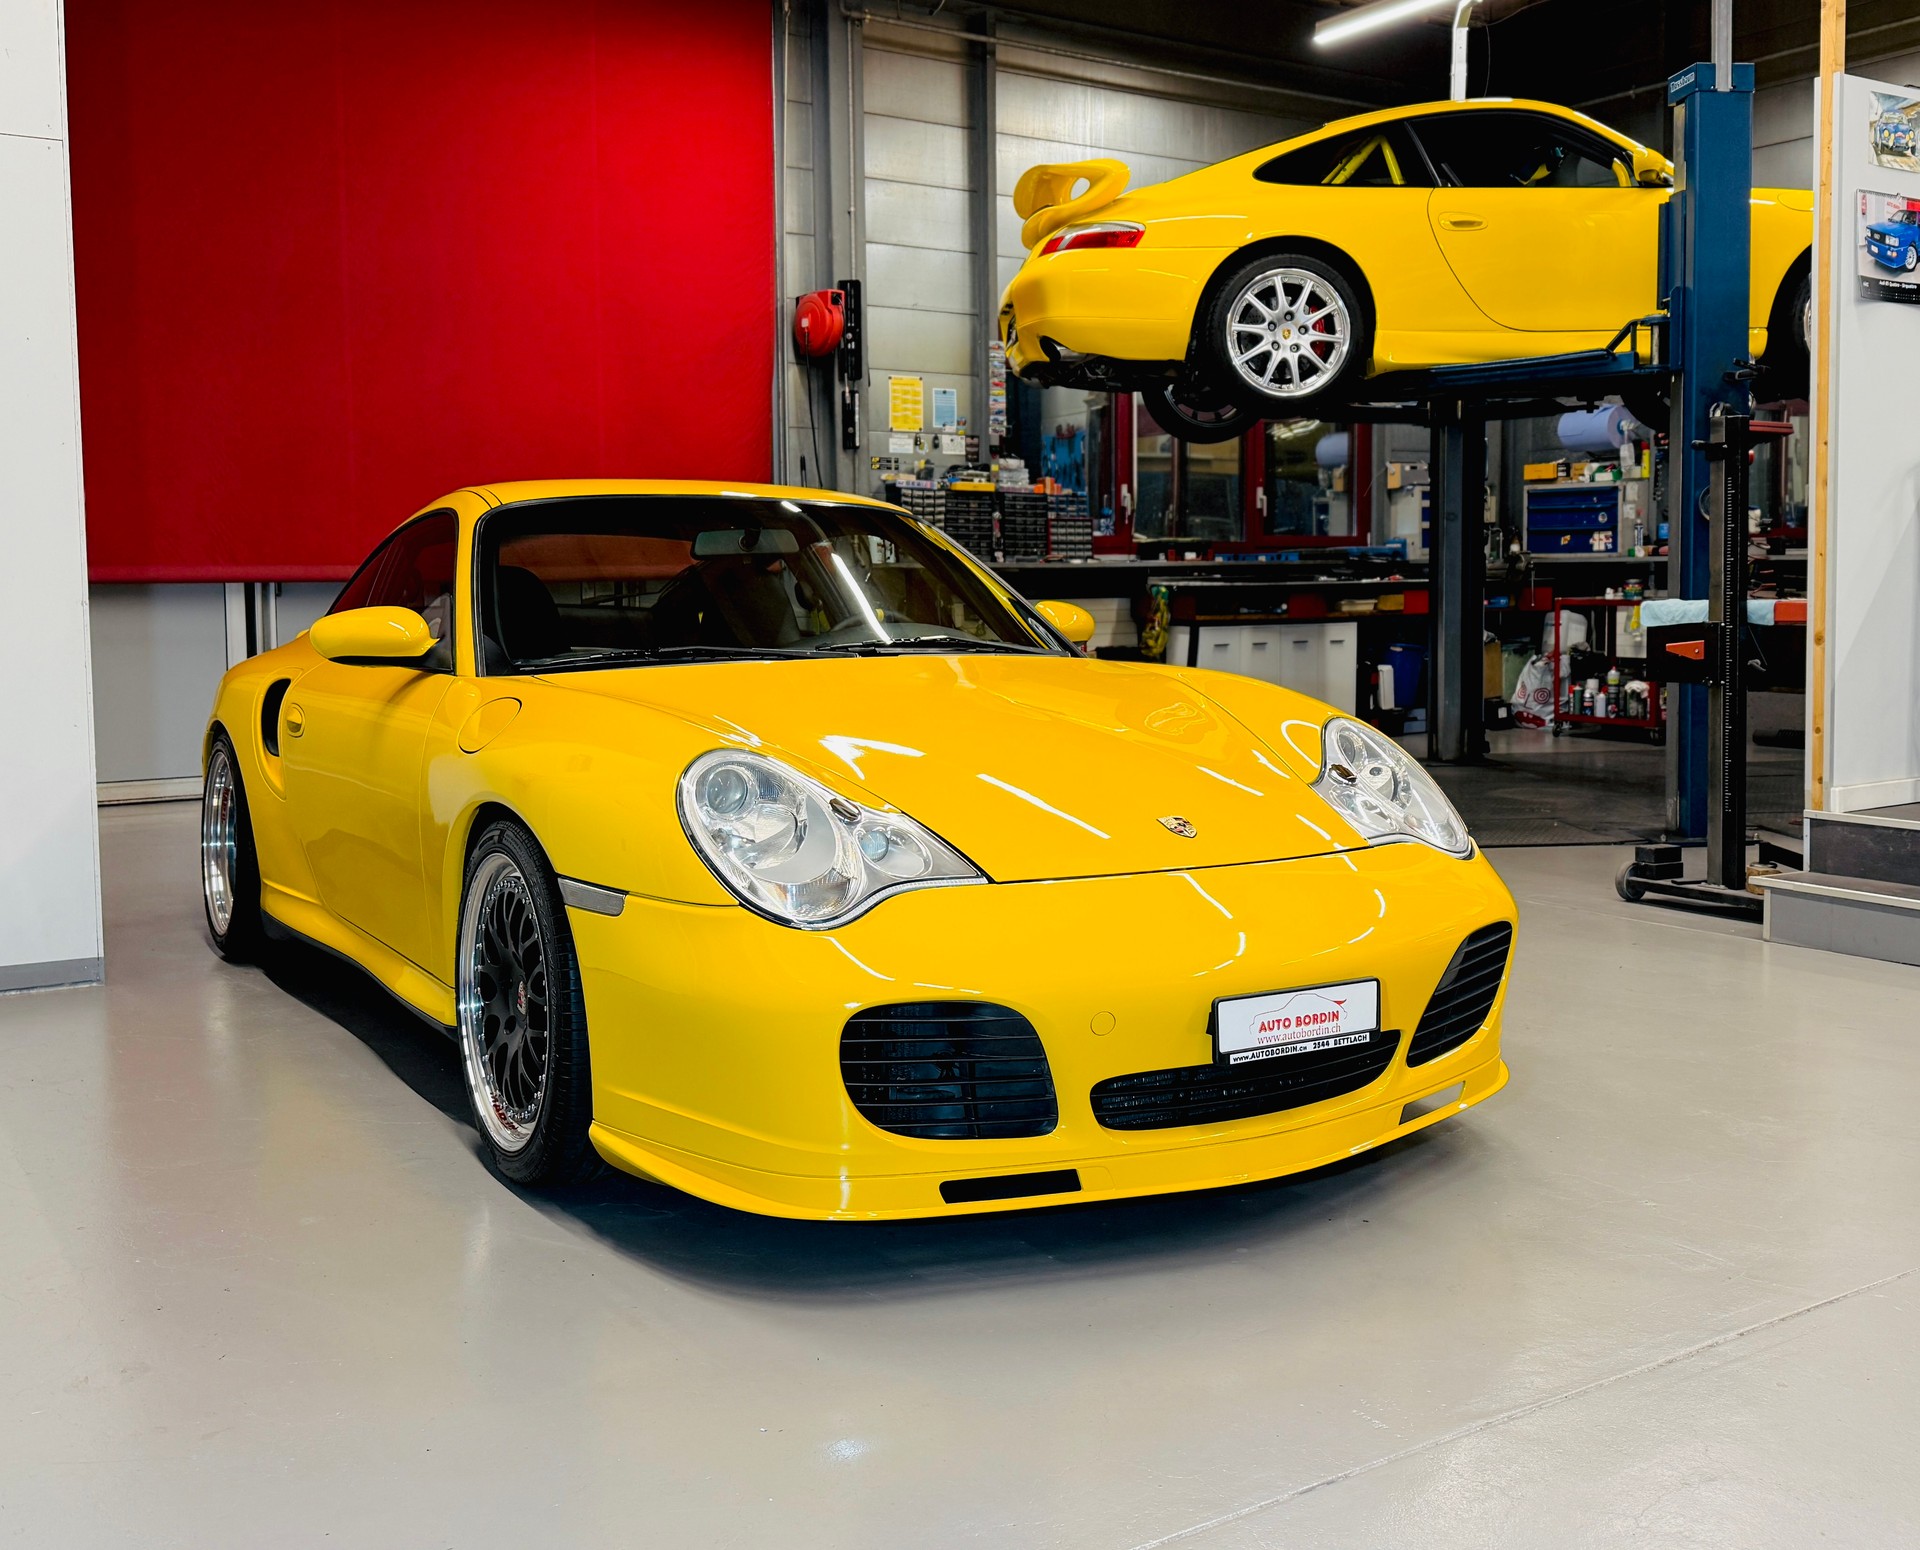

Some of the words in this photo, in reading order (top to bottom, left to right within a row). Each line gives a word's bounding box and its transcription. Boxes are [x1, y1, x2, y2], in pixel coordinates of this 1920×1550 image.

[1258, 1017, 1292, 1034] AUTO
[1295, 1010, 1340, 1028] BORDIN
[1257, 1023, 1341, 1045] www.autobordin.ch
[1312, 1040, 1330, 1050] 2544
[1333, 1034, 1368, 1047] BETTLACH
